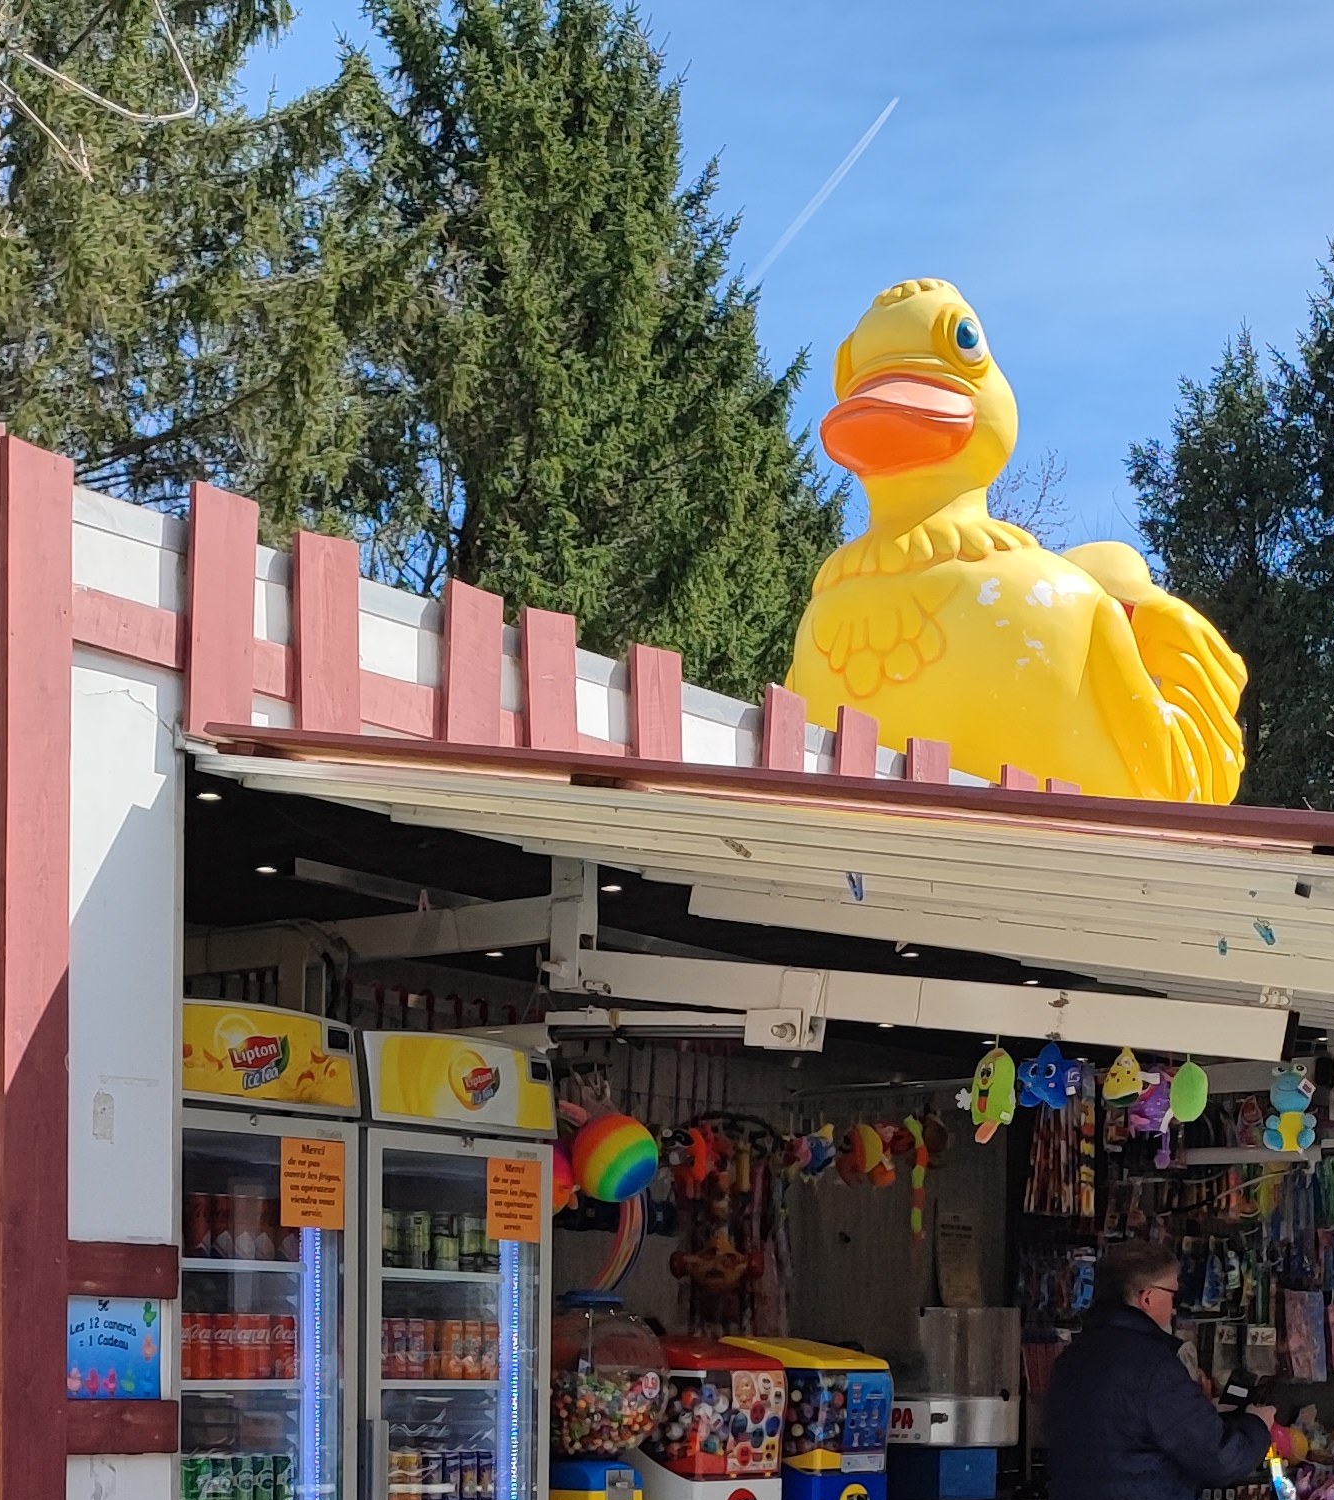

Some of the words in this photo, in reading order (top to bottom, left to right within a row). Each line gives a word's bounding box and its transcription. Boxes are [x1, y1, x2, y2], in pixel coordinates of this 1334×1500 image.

[233, 1043, 277, 1065] Lipton
[242, 1071, 261, 1089] Ice
[260, 1065, 280, 1084] Tea
[464, 1072, 493, 1089] Lipton
[301, 1144, 326, 1156] Merci
[287, 1156, 296, 1166] de
[504, 1163, 526, 1175] Merci
[69, 1322, 85, 1336] Les
[89, 1316, 100, 1330] 12
[102, 1319, 138, 1338] canards
[97, 1333, 129, 1351] Cadeau
